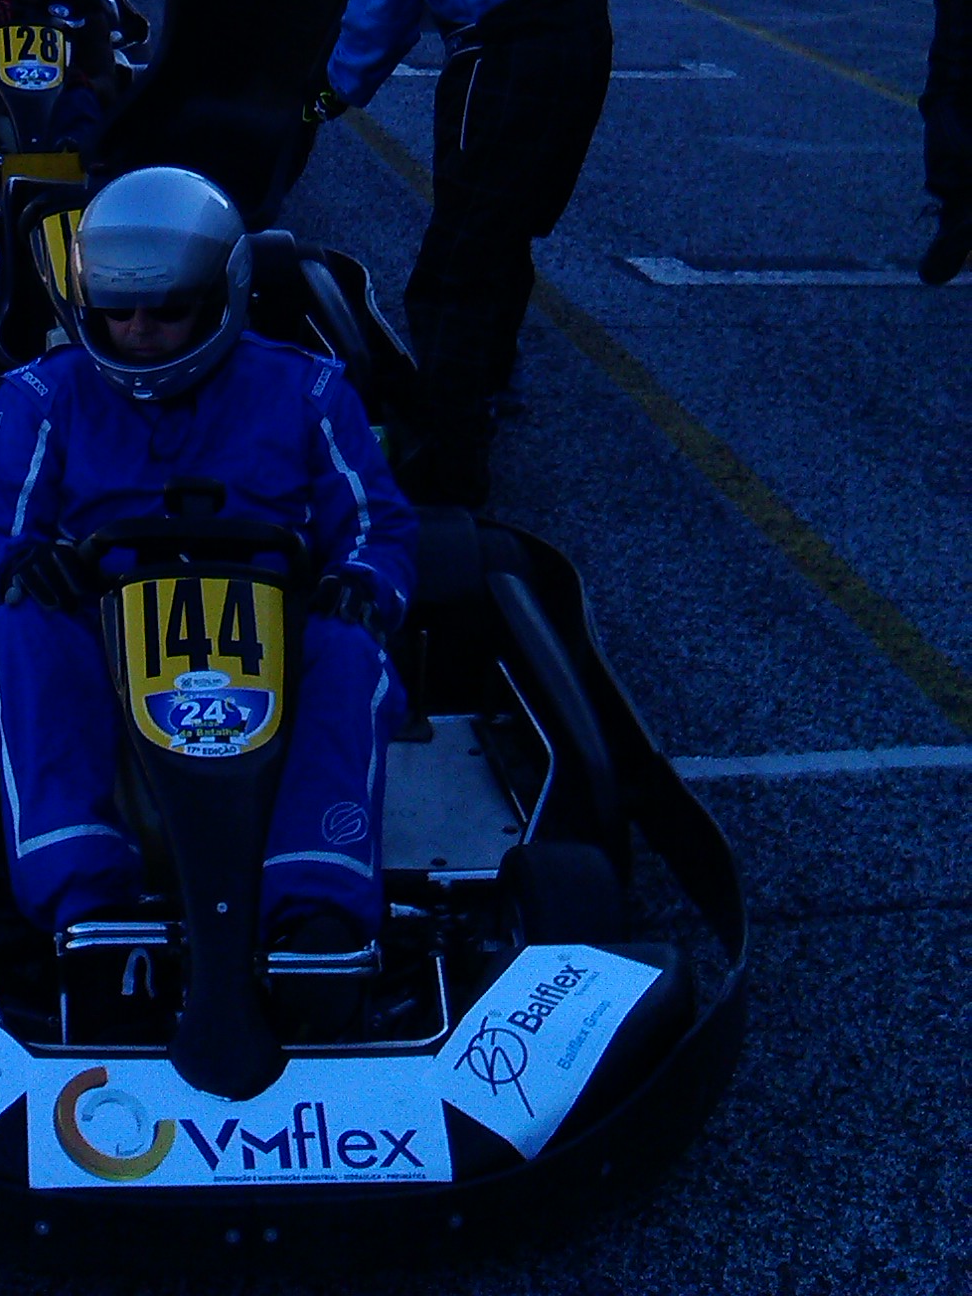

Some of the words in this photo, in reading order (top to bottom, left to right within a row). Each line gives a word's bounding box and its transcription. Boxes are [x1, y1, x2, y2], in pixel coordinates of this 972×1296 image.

[2, 25, 59, 63] 128
[142, 577, 263, 678] 144
[179, 700, 227, 726] 24
[506, 964, 589, 1035] Balflex
